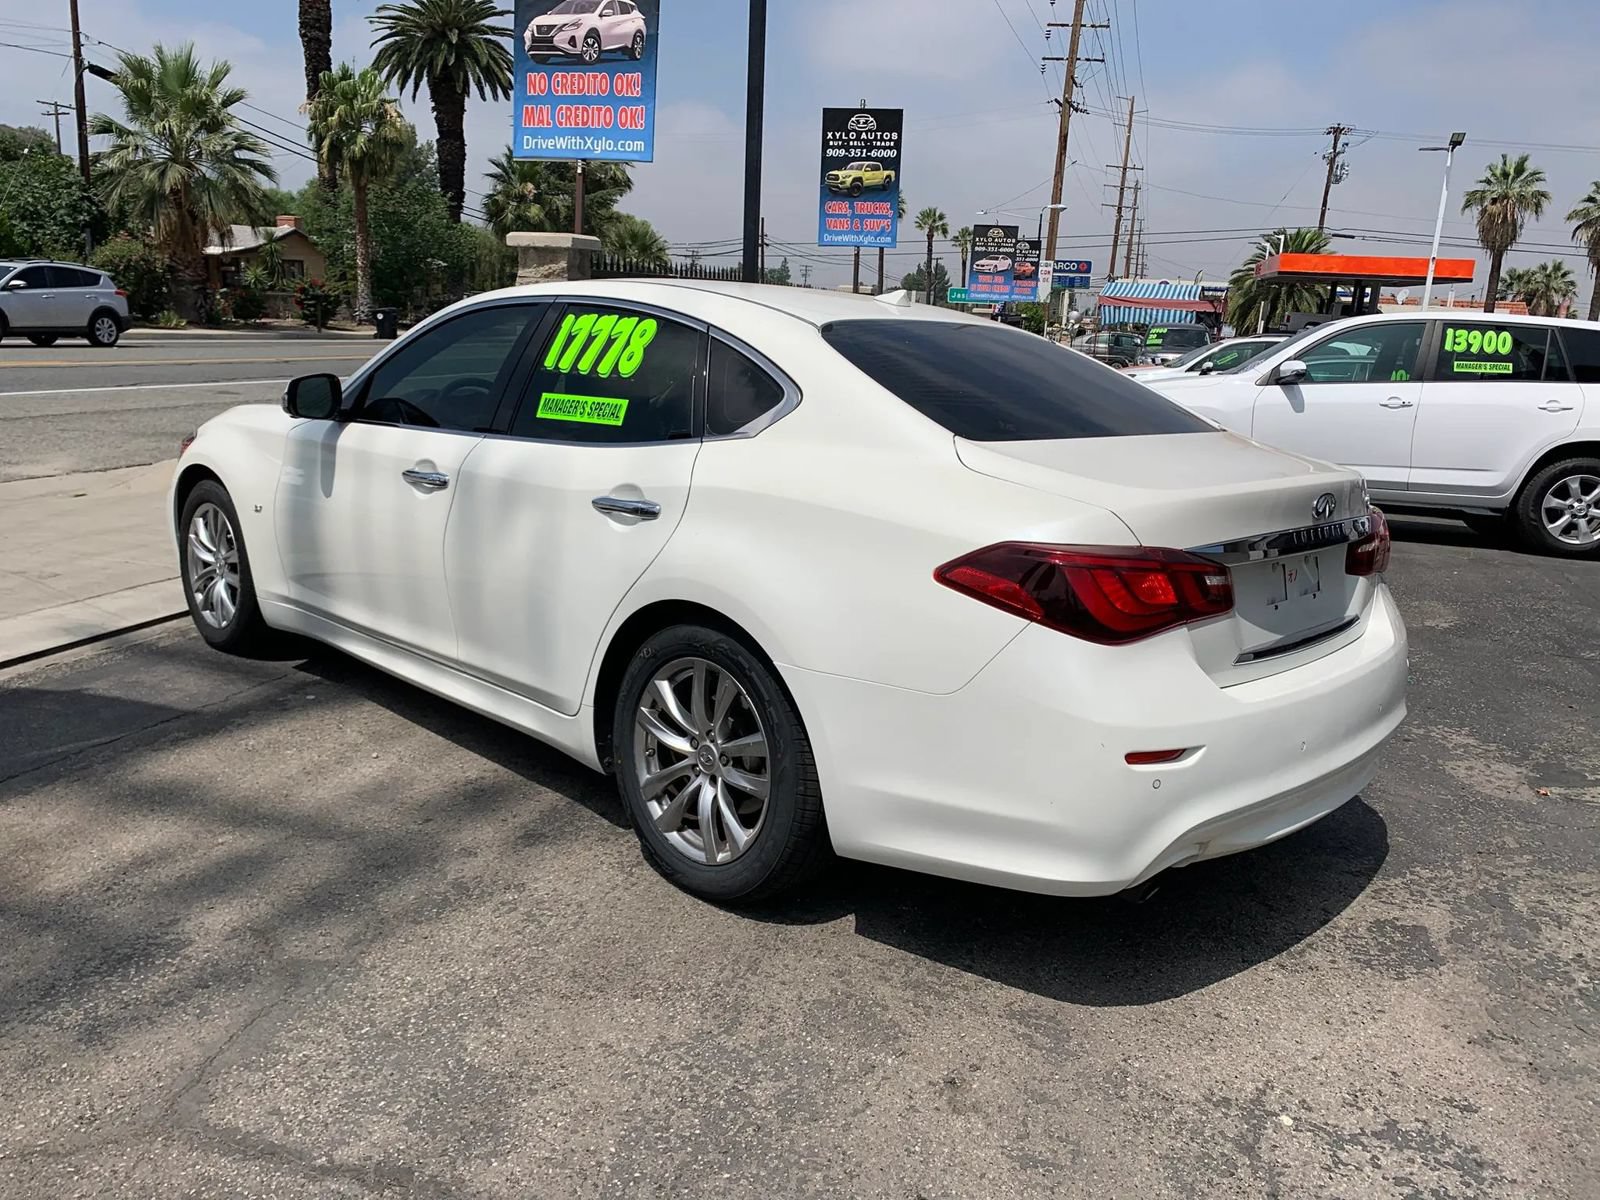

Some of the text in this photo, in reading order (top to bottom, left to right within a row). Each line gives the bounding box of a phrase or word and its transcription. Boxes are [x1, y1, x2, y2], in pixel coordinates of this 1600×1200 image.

[527, 72, 641, 97] NO CREDITO OK!
[522, 105, 645, 130] MAL CREDITO OK!
[860, 132, 898, 140] AUTOS
[523, 136, 644, 153] DriveWithXylo.com
[826, 148, 897, 158] 909-351-6000
[825, 201, 893, 217] CARS, TRUCKS,
[826, 218, 851, 230] VANS
[853, 219, 860, 231] &
[823, 234, 891, 244] DriveWithXylo.com
[1053, 262, 1077, 270] ARCO
[544, 314, 657, 378] 17778
[1444, 328, 1513, 355] 13900
[1456, 363, 1511, 371] MANAGER'S SPECIAL
[542, 397, 623, 420] MANAGER'S SPECIAL
